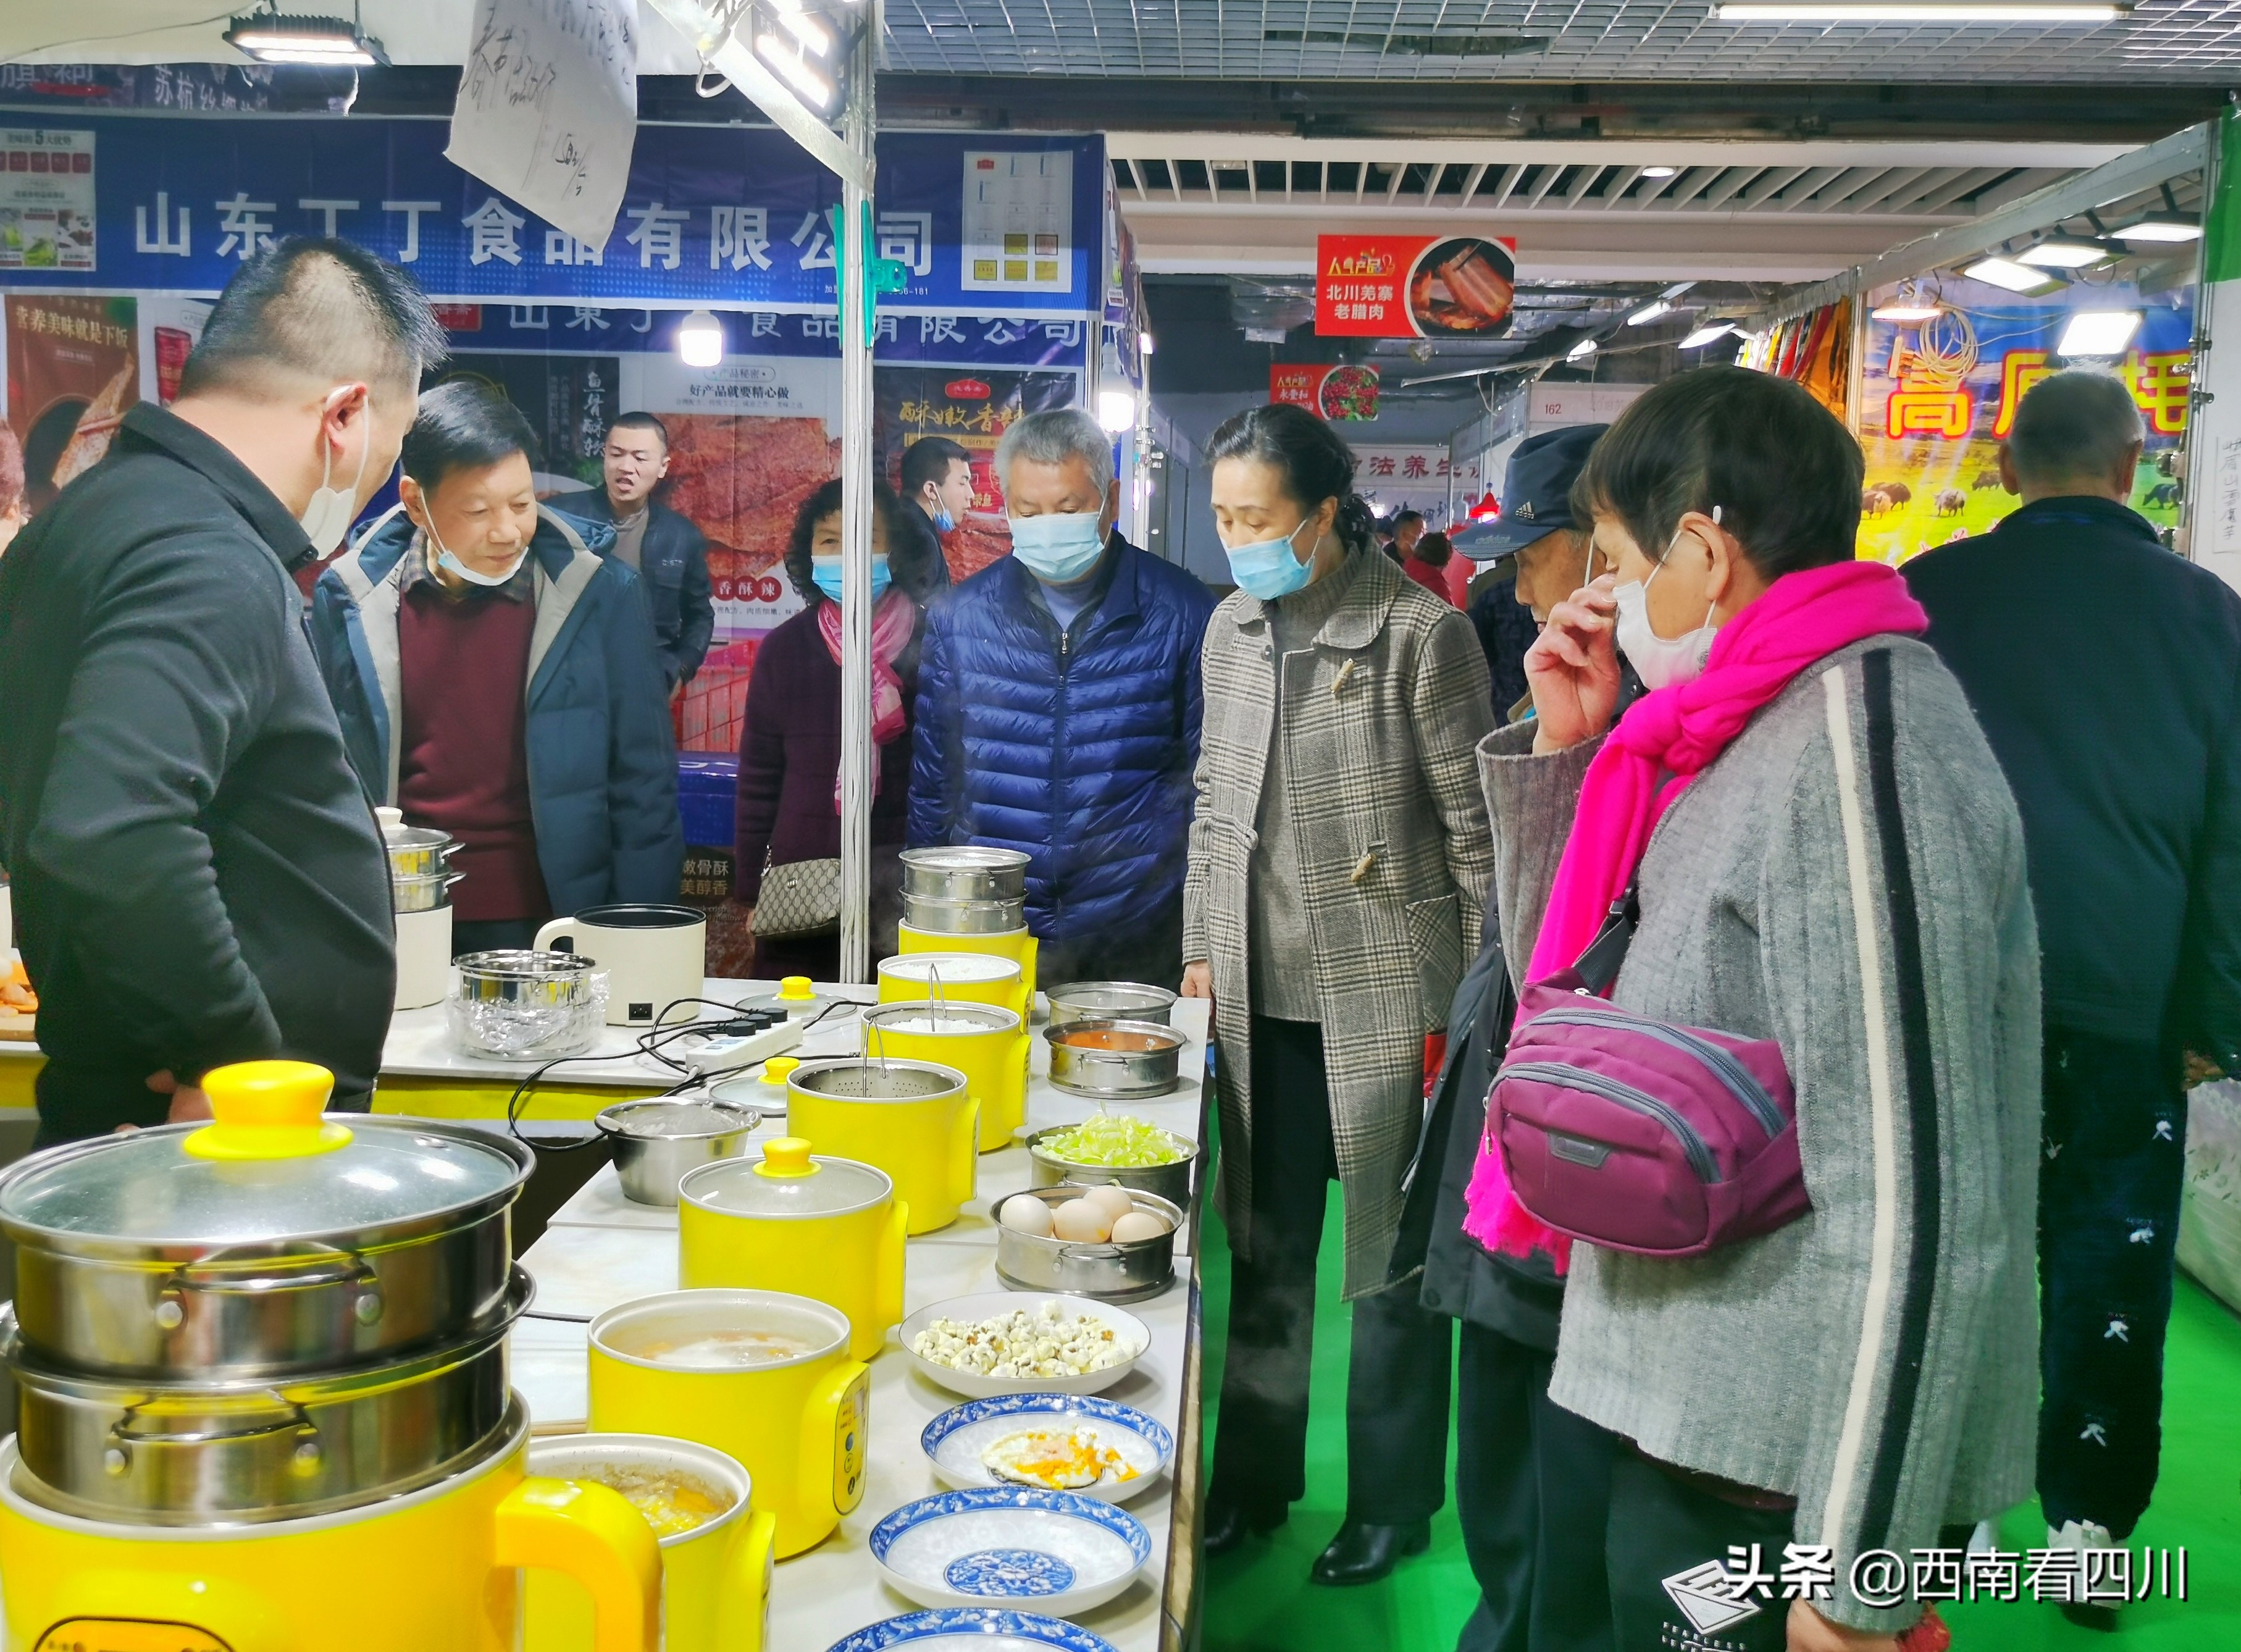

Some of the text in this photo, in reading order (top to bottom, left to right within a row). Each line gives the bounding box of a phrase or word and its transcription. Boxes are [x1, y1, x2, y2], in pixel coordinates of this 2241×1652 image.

[1326, 284, 1393, 301] 北川羌寨
[1334, 303, 1384, 320] 老腊肉
[689, 384, 790, 400] 好产品就要精心做
[1545, 403, 1562, 415] 162
[1351, 455, 1479, 479] 法养生
